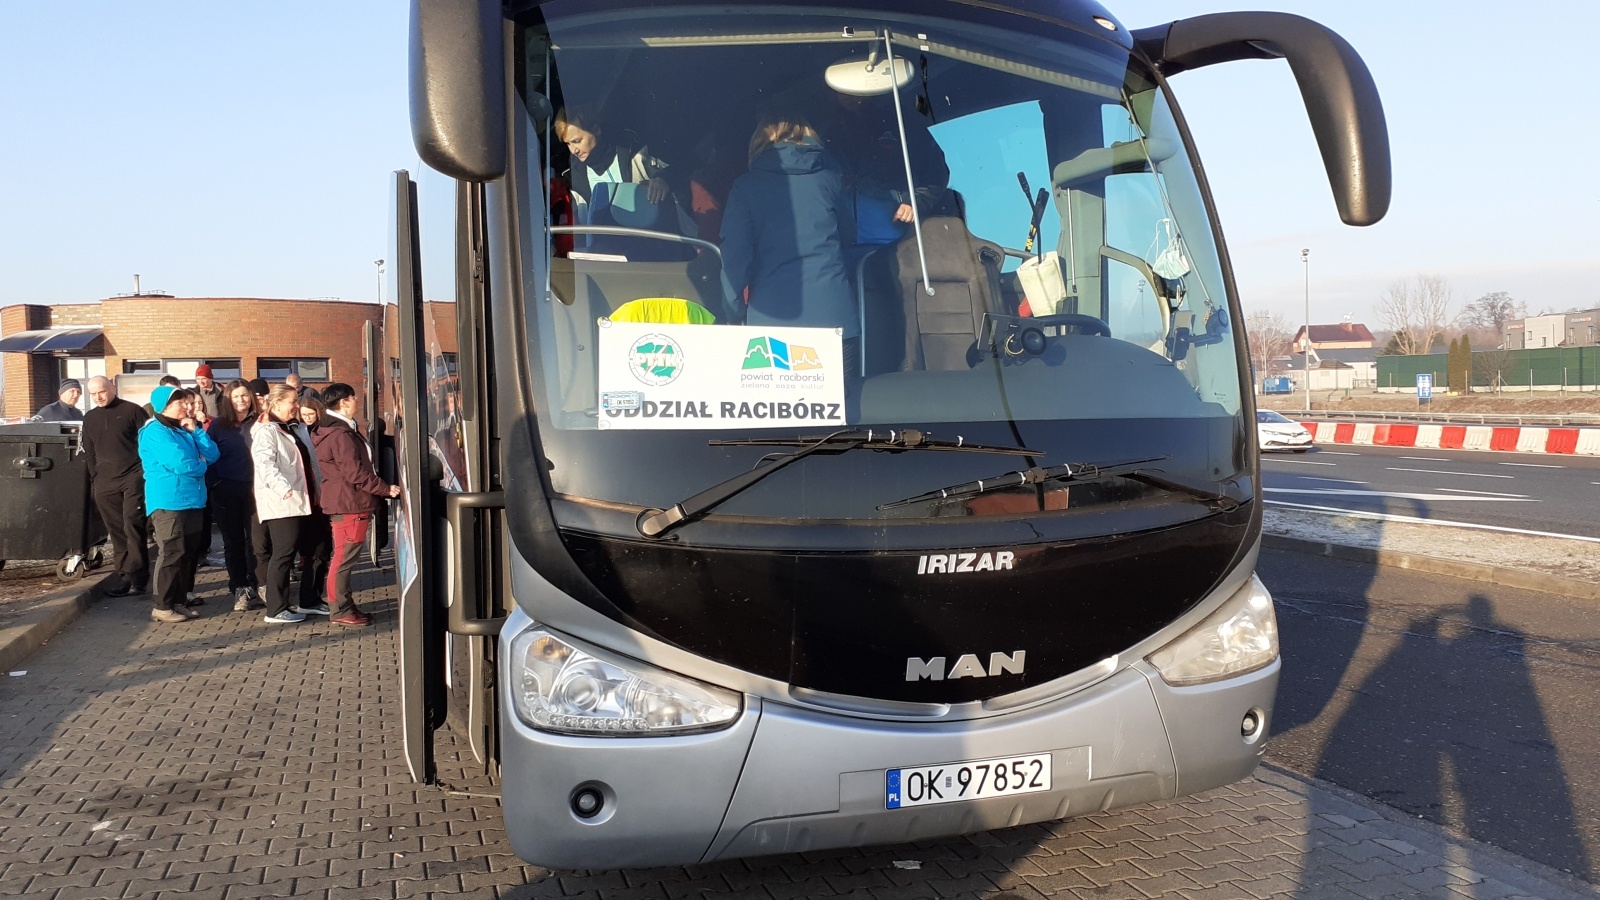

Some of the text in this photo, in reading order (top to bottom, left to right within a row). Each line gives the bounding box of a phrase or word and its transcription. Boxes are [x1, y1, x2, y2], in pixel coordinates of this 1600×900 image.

[635, 352, 677, 367] PTTK
[740, 372, 825, 382] powiat raciborski
[720, 397, 841, 420] RACIBÓRZ
[917, 551, 1014, 575] IRIZAR
[905, 649, 1026, 682] MAN
[907, 758, 1044, 802] OK 97852
[888, 793, 899, 802] PL
